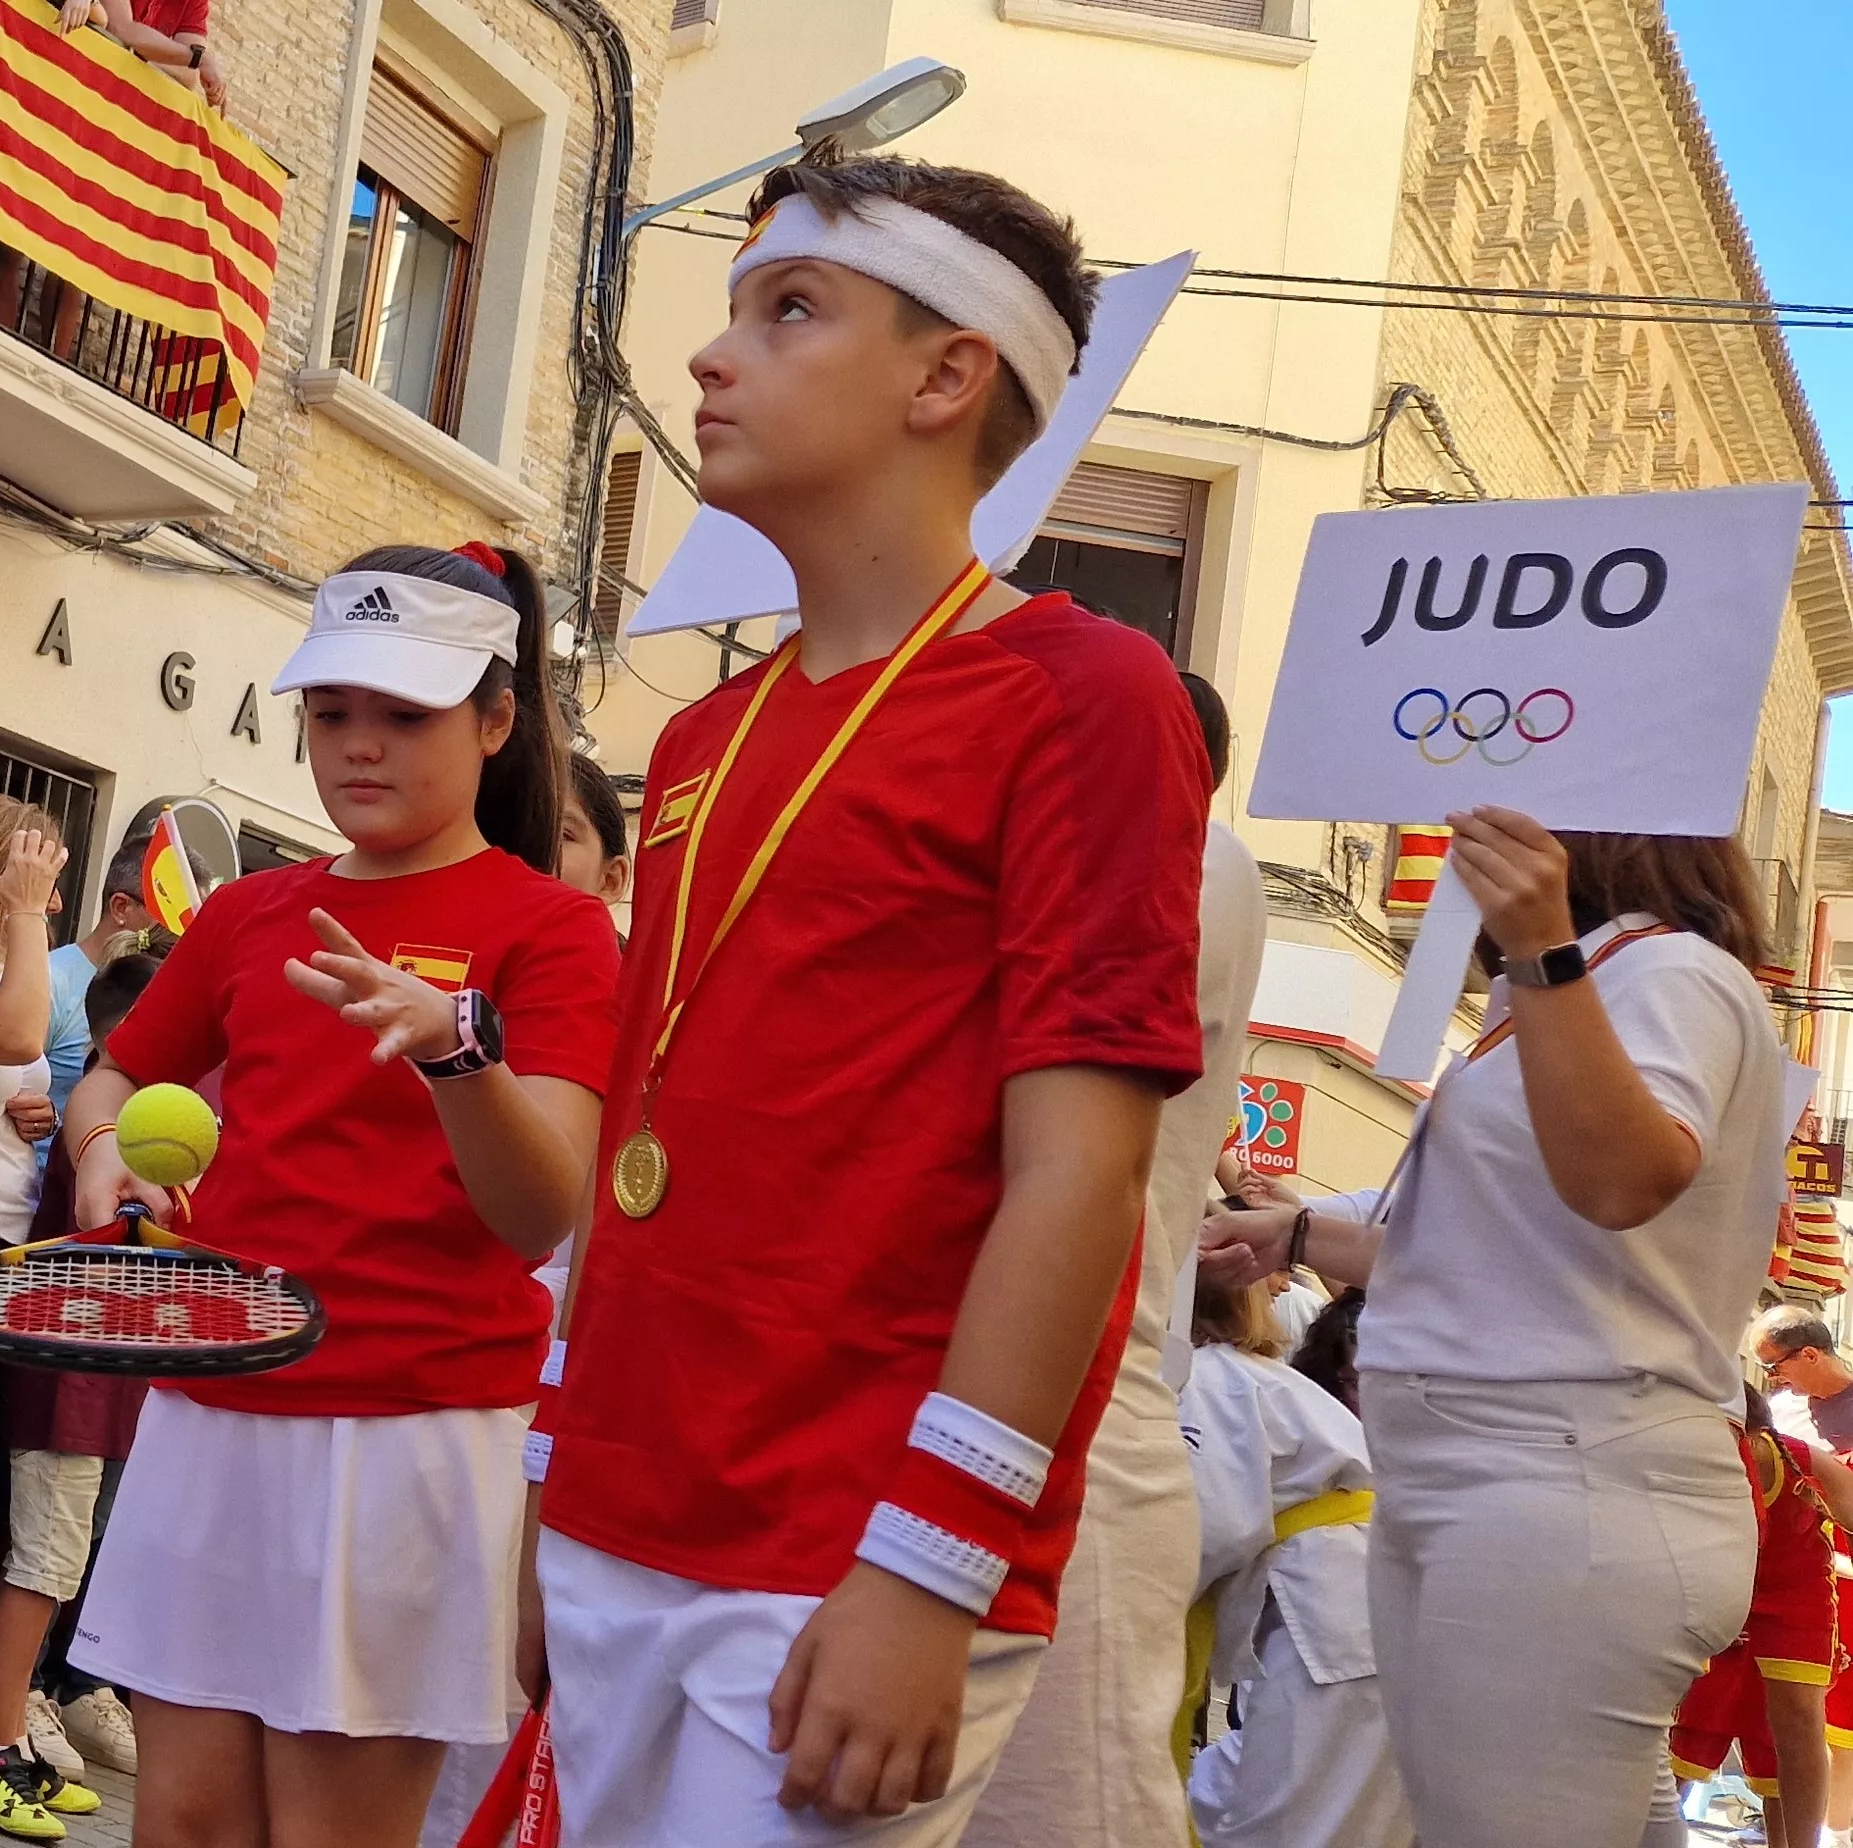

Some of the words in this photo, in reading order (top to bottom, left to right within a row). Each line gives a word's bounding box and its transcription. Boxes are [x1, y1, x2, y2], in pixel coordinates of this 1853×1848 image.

[345, 607, 400, 623] adidas
[1360, 547, 1668, 648] JUDO
[160, 650, 309, 764] GA
[1252, 1150, 1294, 1169] 6000
[519, 1792, 542, 1845] PRO
